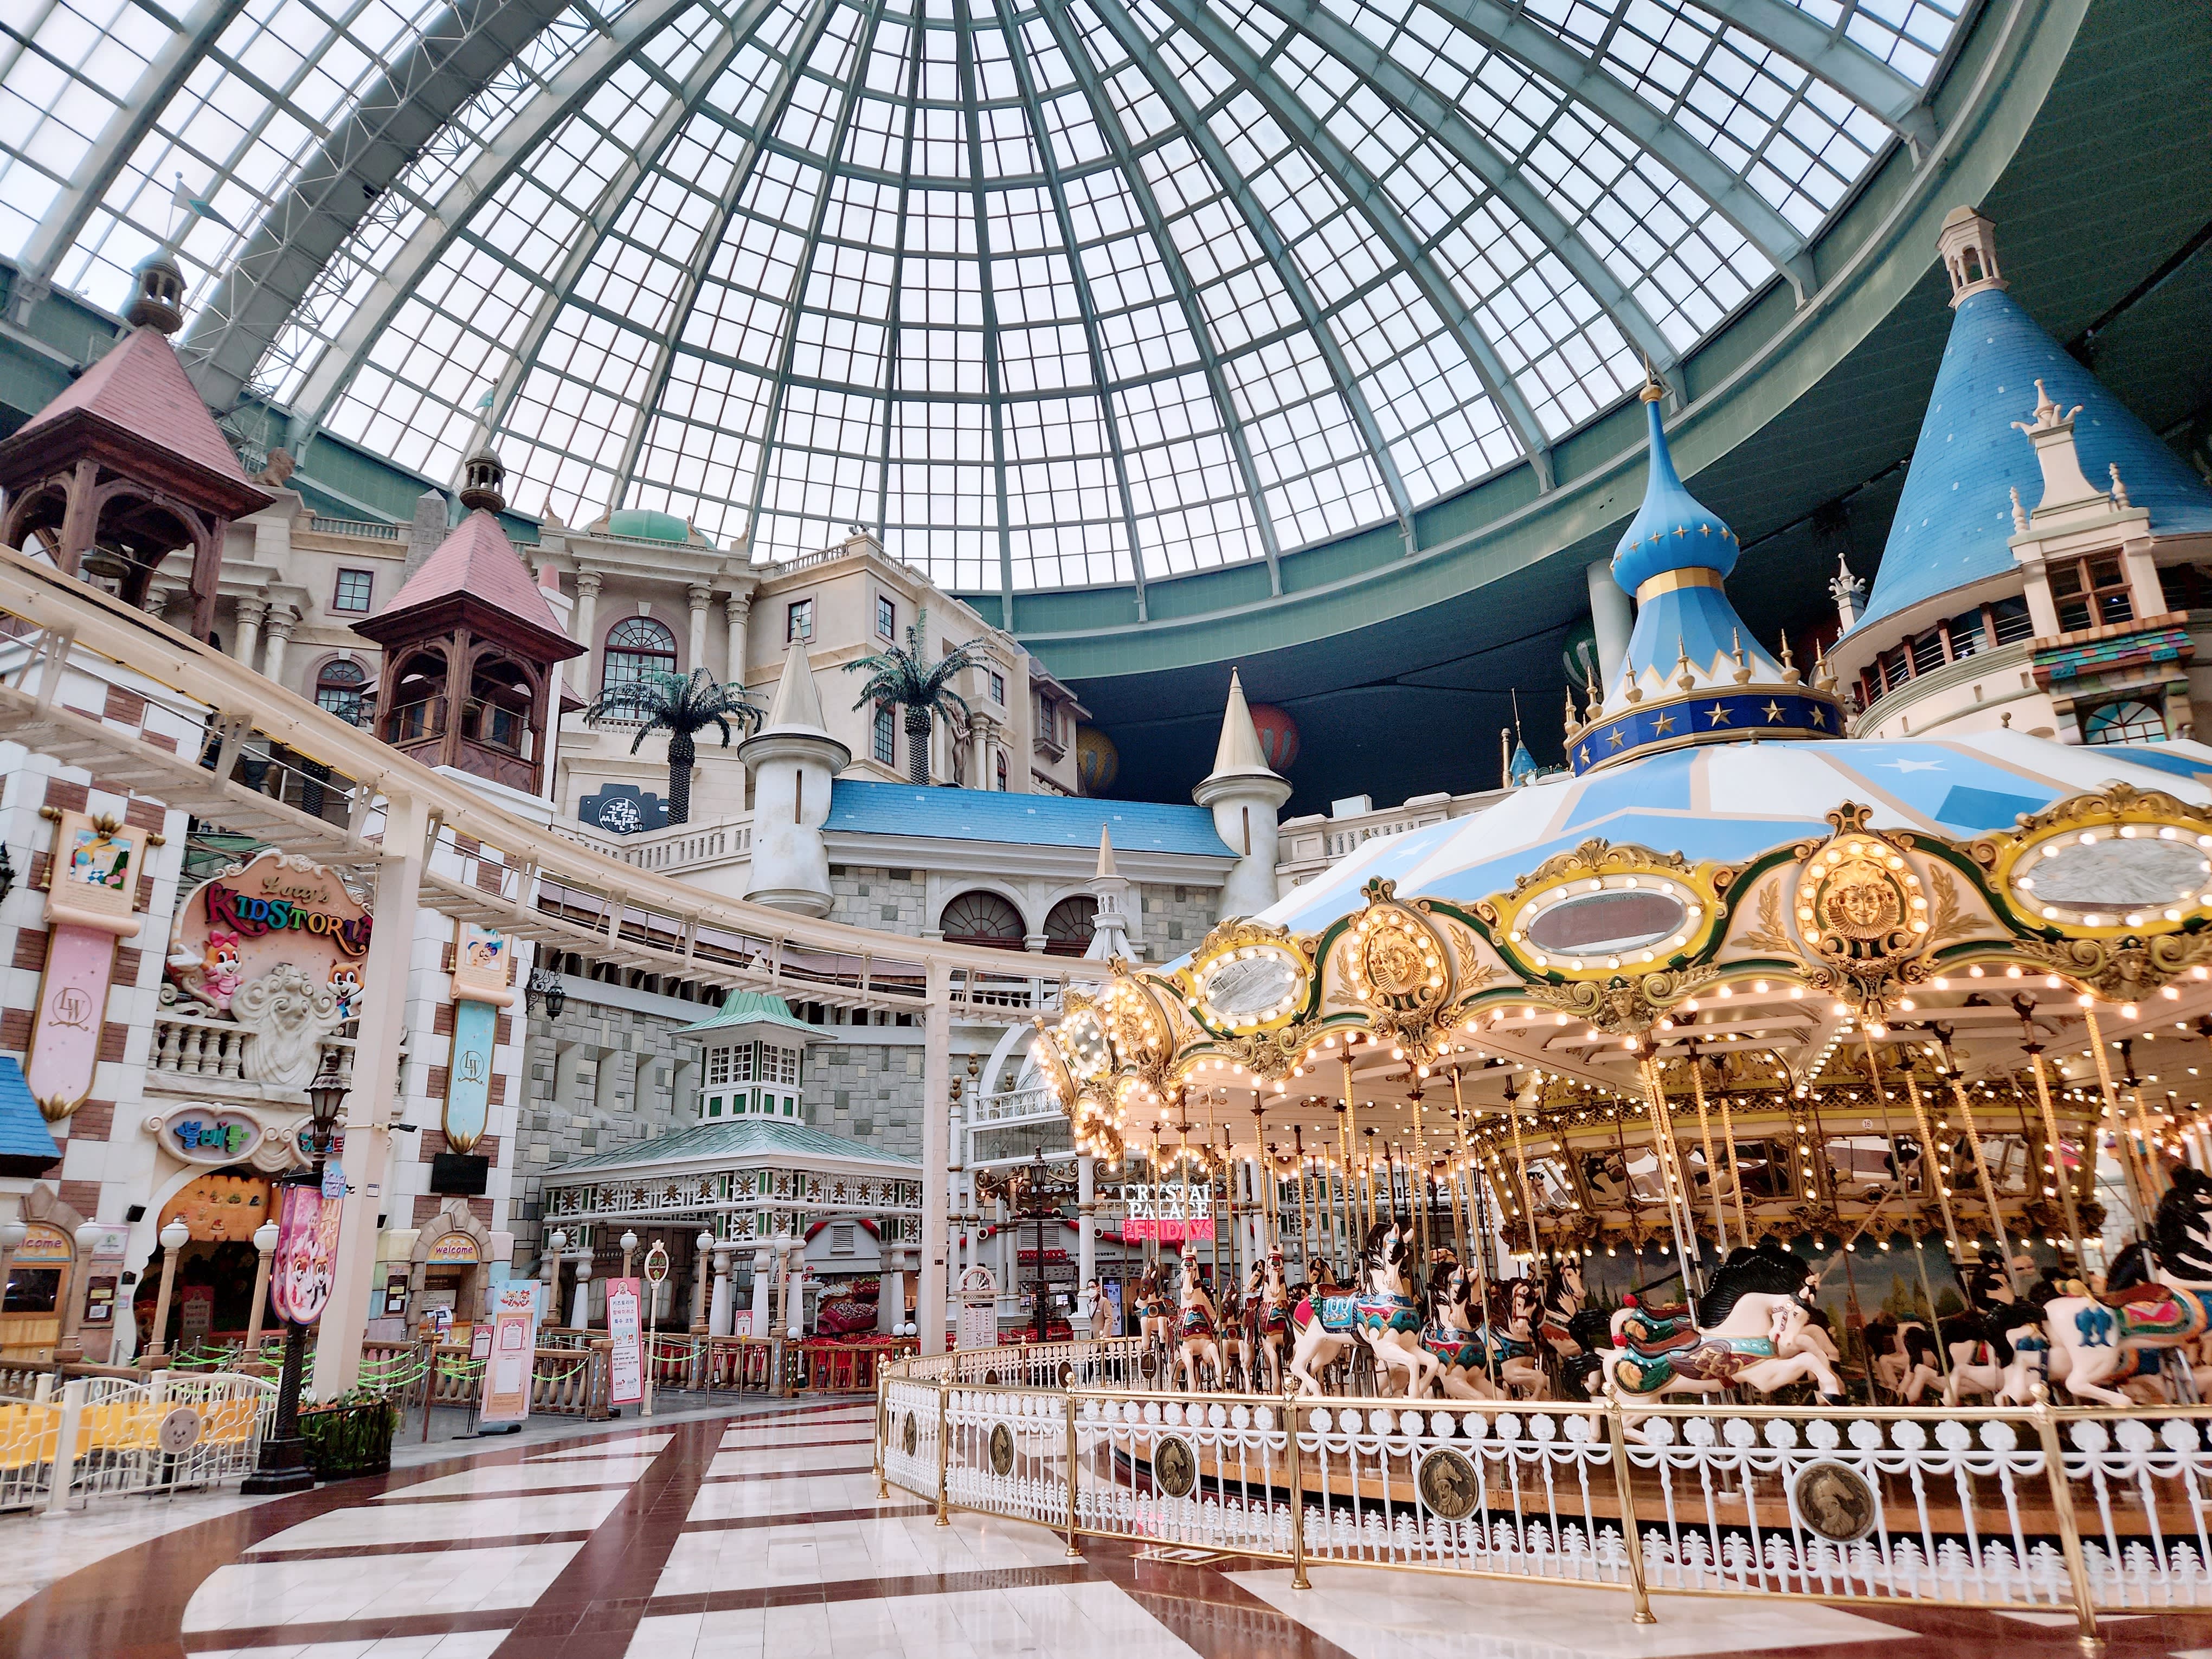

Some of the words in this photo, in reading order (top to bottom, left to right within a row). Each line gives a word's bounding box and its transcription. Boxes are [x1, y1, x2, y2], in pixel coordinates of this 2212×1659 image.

[1121, 1184, 1213, 1202] CRYSTAL
[1128, 1201, 1209, 1220] PALACE
[1134, 1220, 1214, 1240] FRIDAYS
[16, 1238, 62, 1248] lcome
[435, 1245, 473, 1253] welcome
